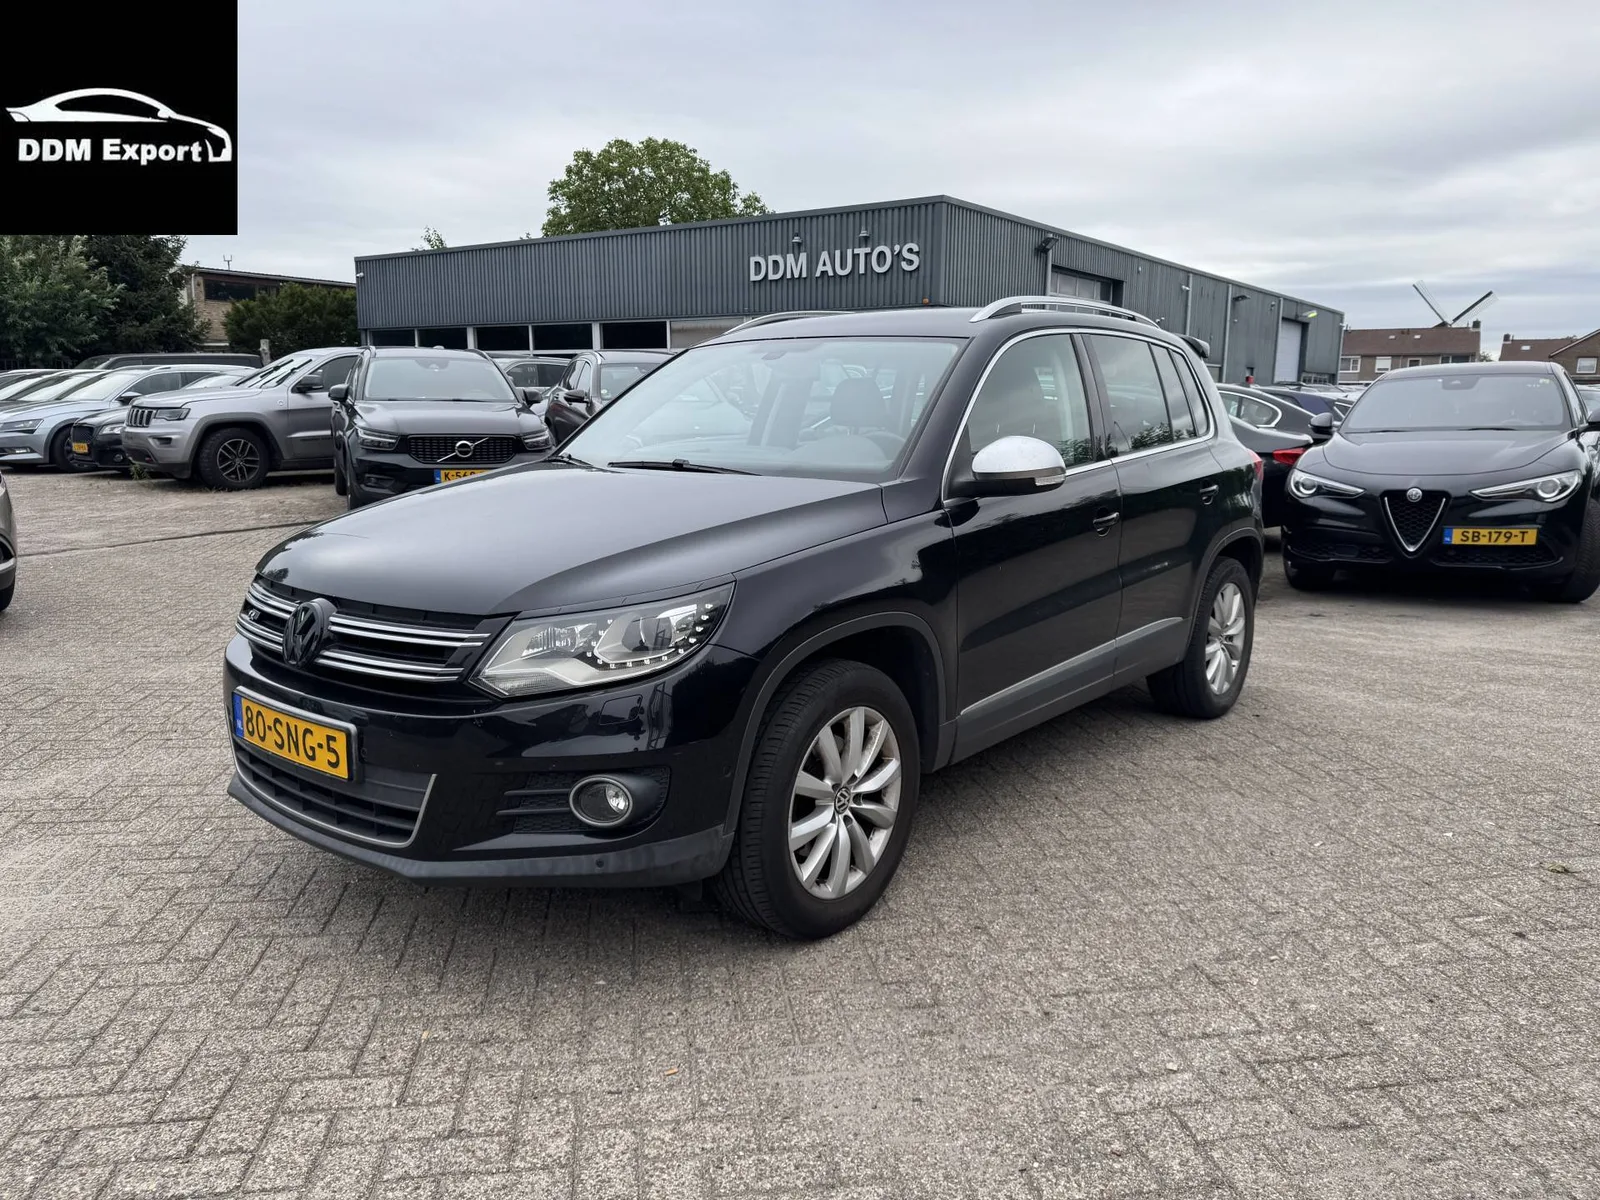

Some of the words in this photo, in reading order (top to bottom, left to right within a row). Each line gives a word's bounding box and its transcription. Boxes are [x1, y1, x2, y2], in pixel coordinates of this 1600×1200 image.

[749, 252, 807, 282] DDM
[815, 242, 920, 278] AUTO'S
[1460, 530, 1528, 543] SB-179-T
[245, 705, 340, 769] 80-SNG-5
